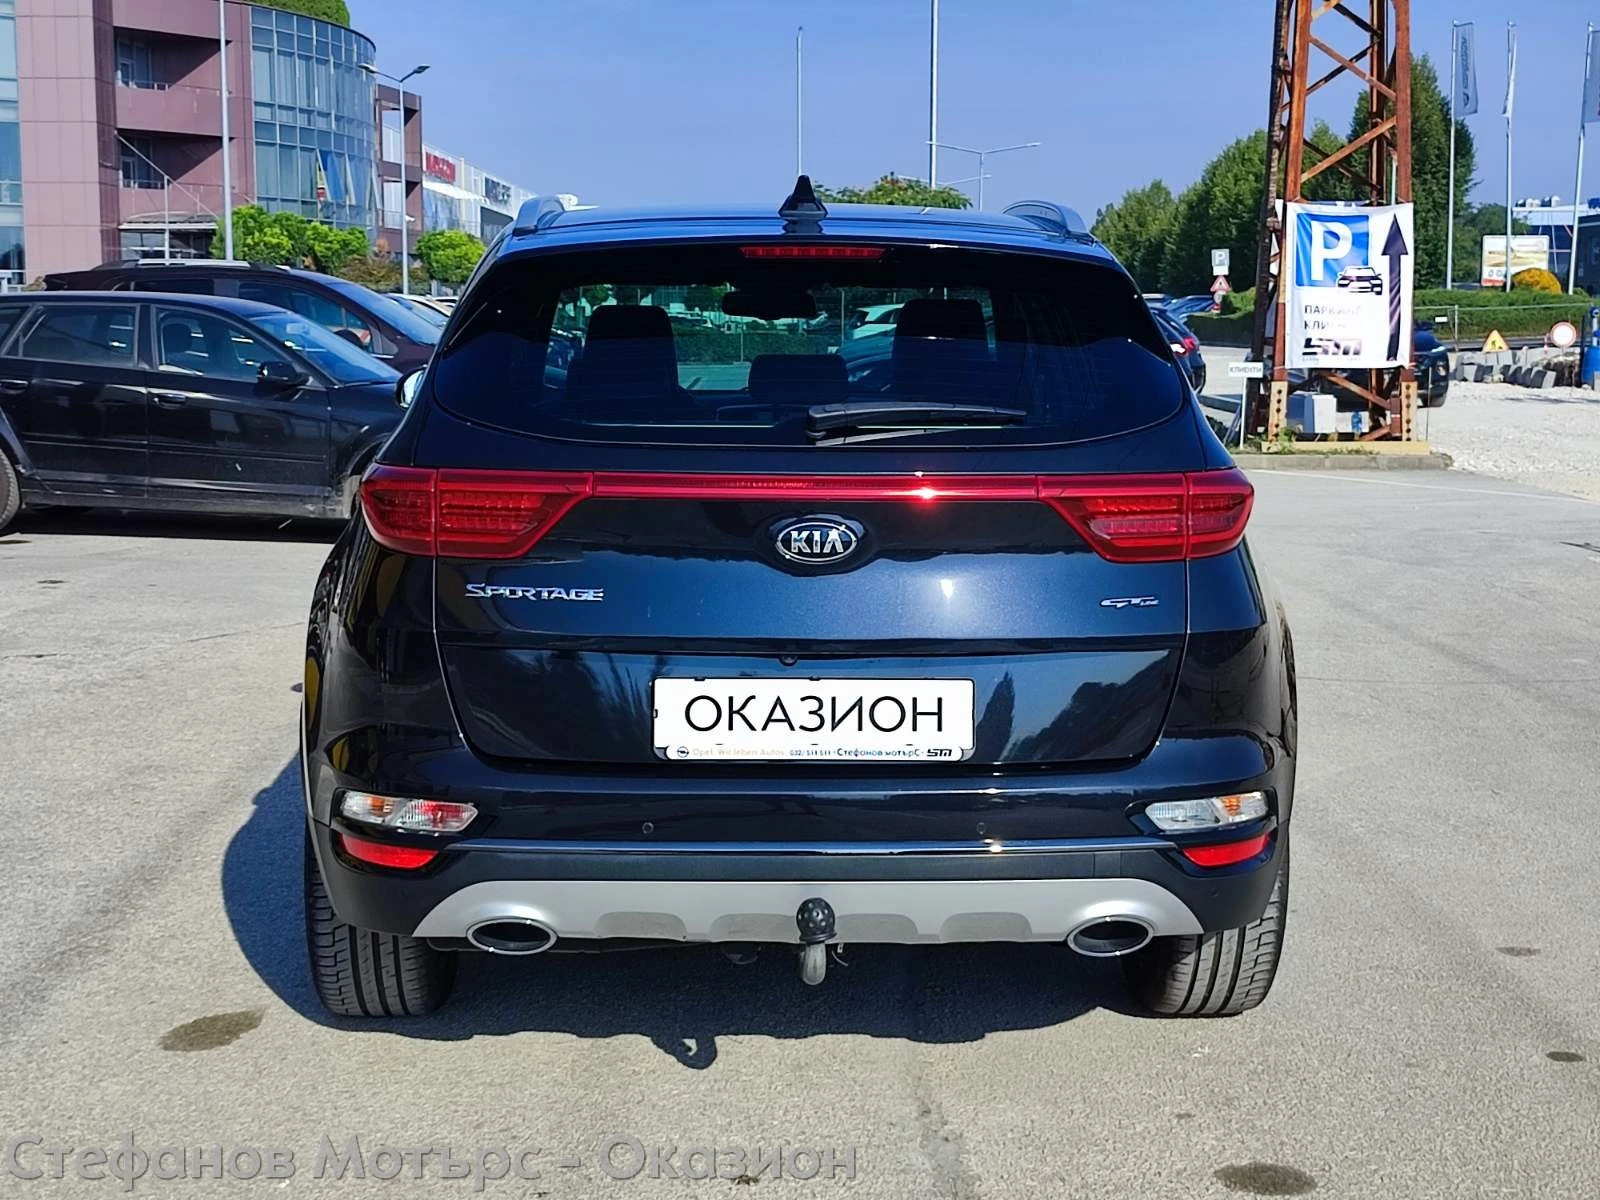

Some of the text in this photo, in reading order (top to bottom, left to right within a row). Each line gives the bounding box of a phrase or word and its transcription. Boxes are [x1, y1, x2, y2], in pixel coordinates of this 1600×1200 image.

[1311, 220, 1353, 281] P
[790, 528, 844, 554] KIA
[465, 583, 604, 601] SPORTAGE
[684, 694, 944, 733] ОКАЗИОН
